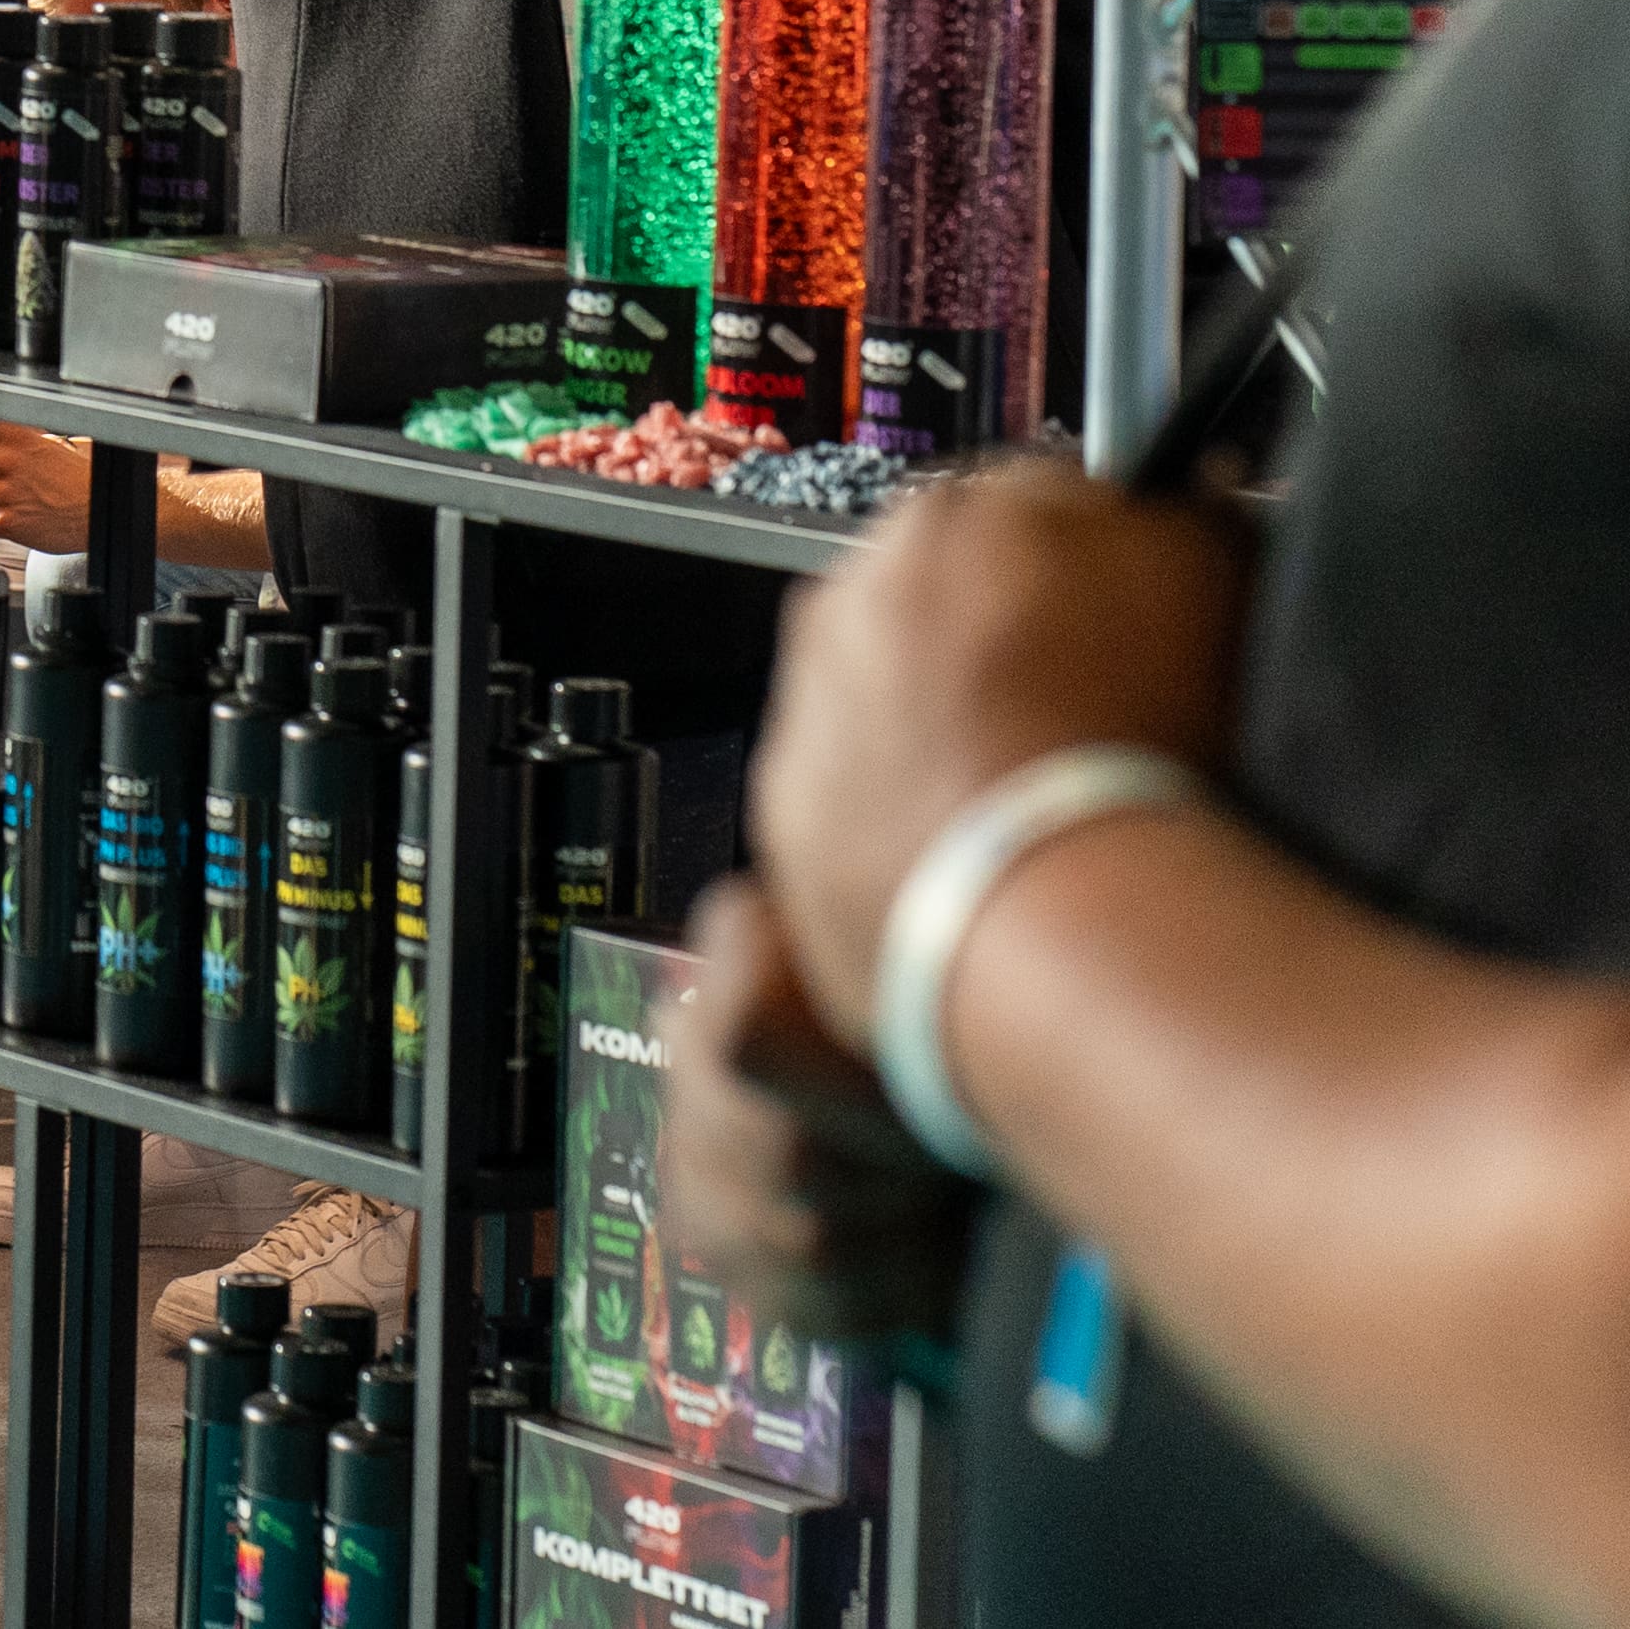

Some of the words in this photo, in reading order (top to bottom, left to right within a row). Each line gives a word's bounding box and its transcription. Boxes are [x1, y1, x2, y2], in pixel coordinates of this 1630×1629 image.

[164, 310, 217, 343] 420
[484, 322, 548, 348] 420
[557, 884, 604, 906] DAS
[624, 1495, 682, 1535] 420
[532, 1526, 771, 1629] KOMPLETTSET
